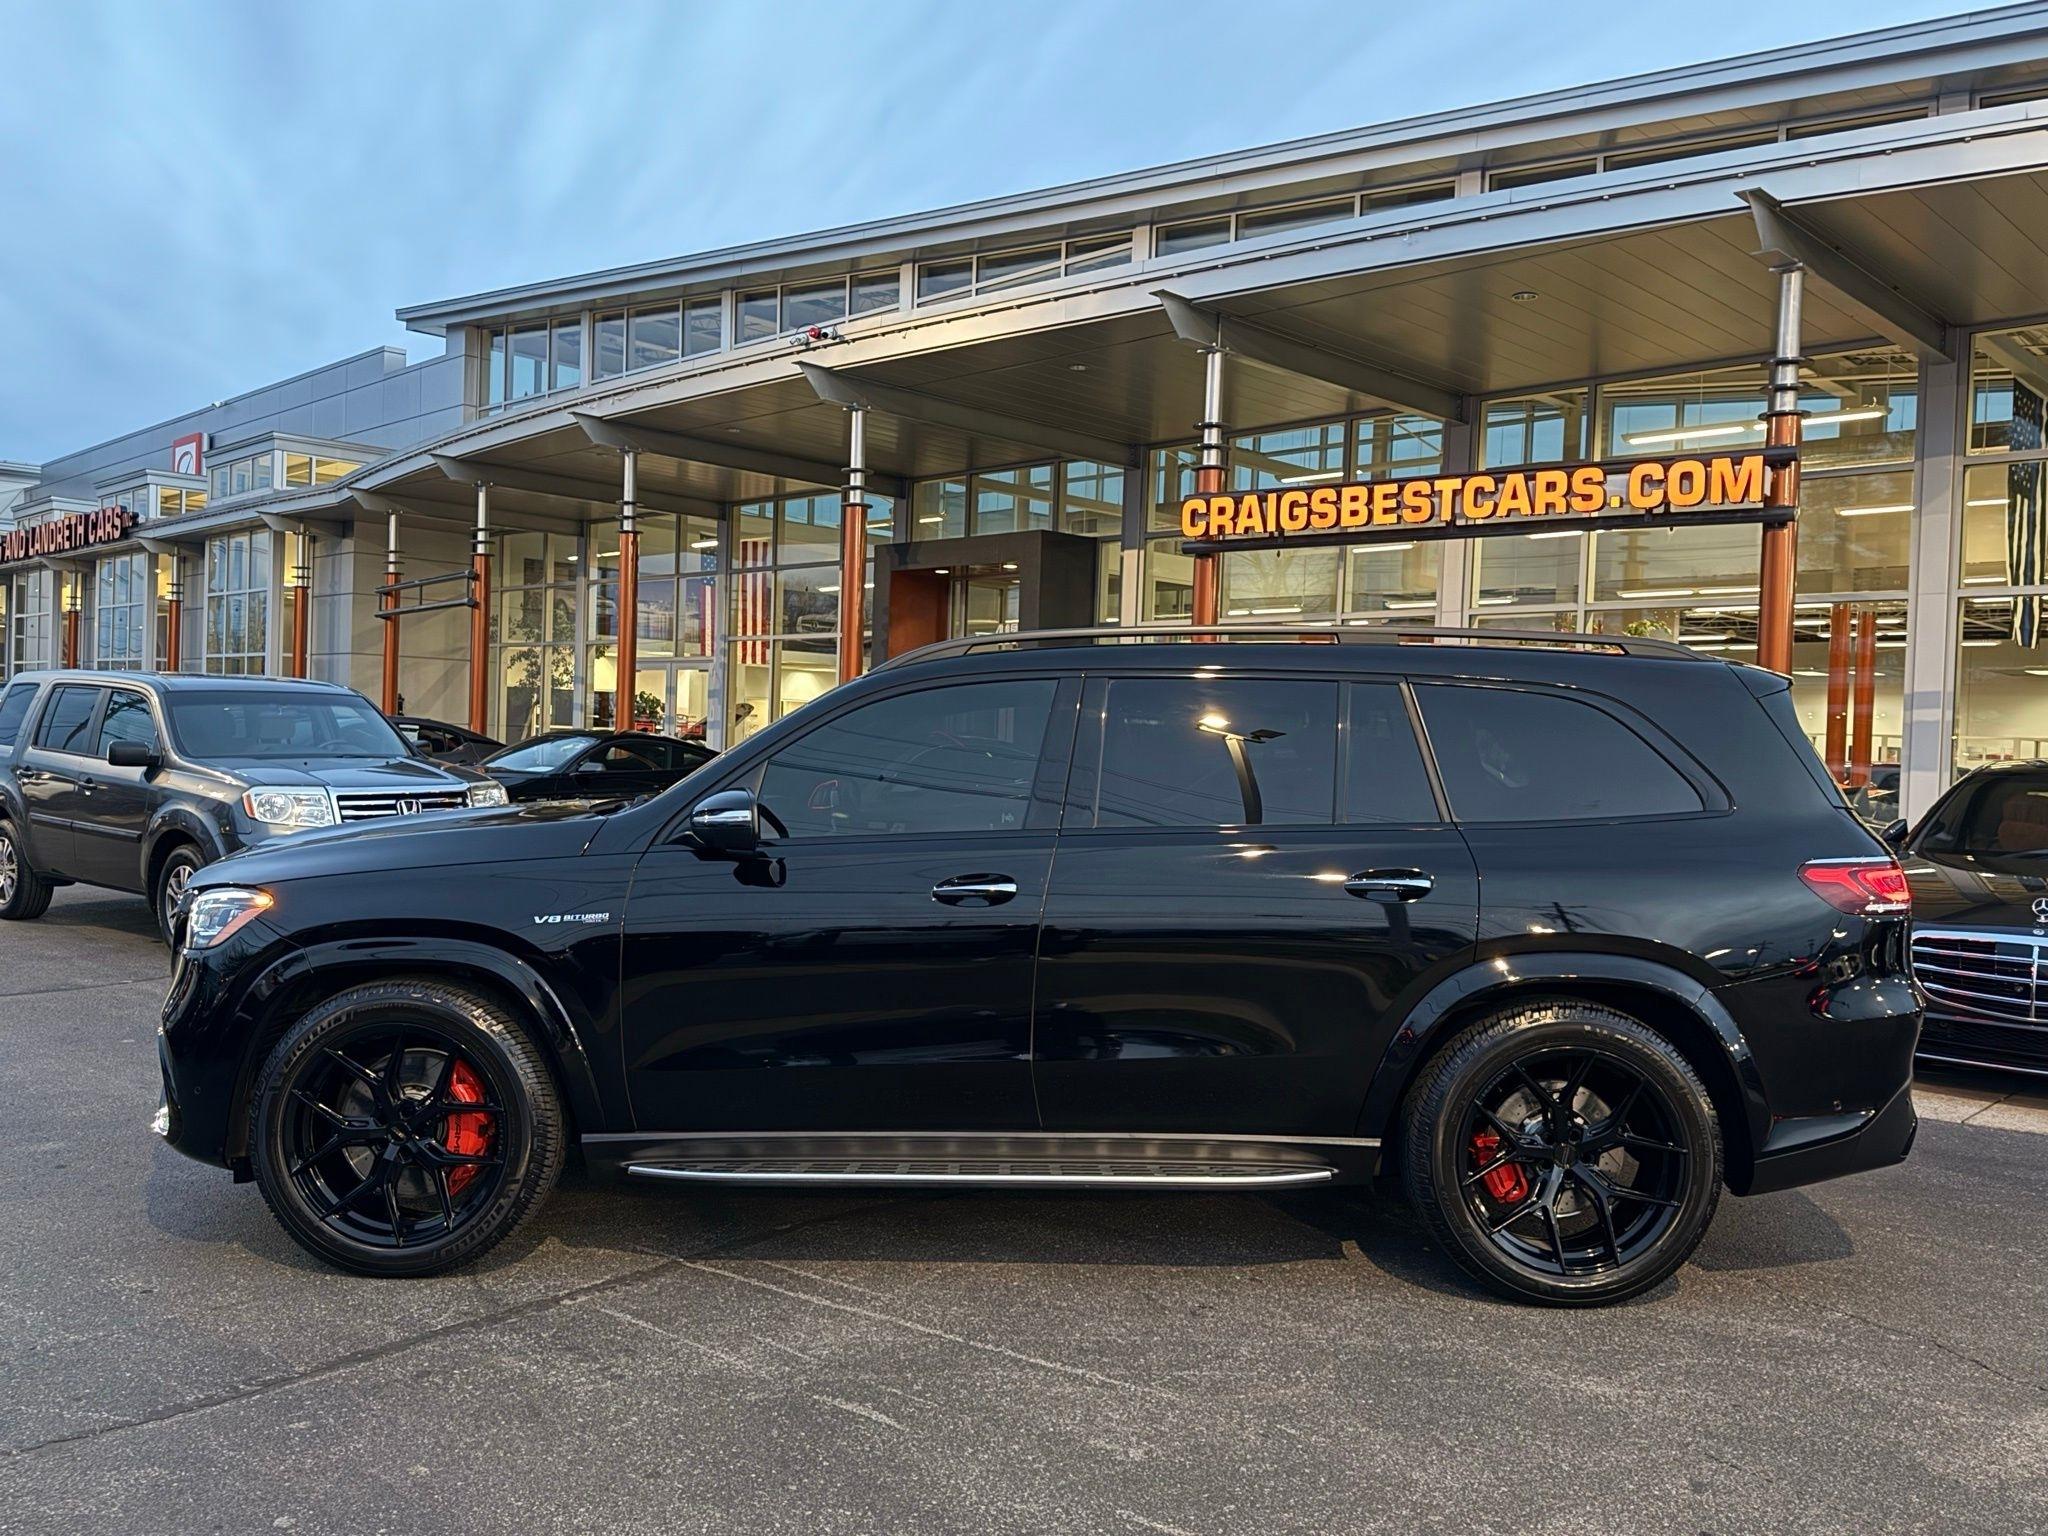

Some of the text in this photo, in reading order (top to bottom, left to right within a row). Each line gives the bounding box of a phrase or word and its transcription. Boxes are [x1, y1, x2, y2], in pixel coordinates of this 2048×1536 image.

[1181, 456, 1765, 538] CRAIGSBESTCARS.COM
[5, 530, 25, 560] AND
[29, 514, 84, 556] LANDRETH
[88, 505, 121, 543] CARS
[534, 915, 561, 923] V8
[563, 912, 609, 922] BITURBO
